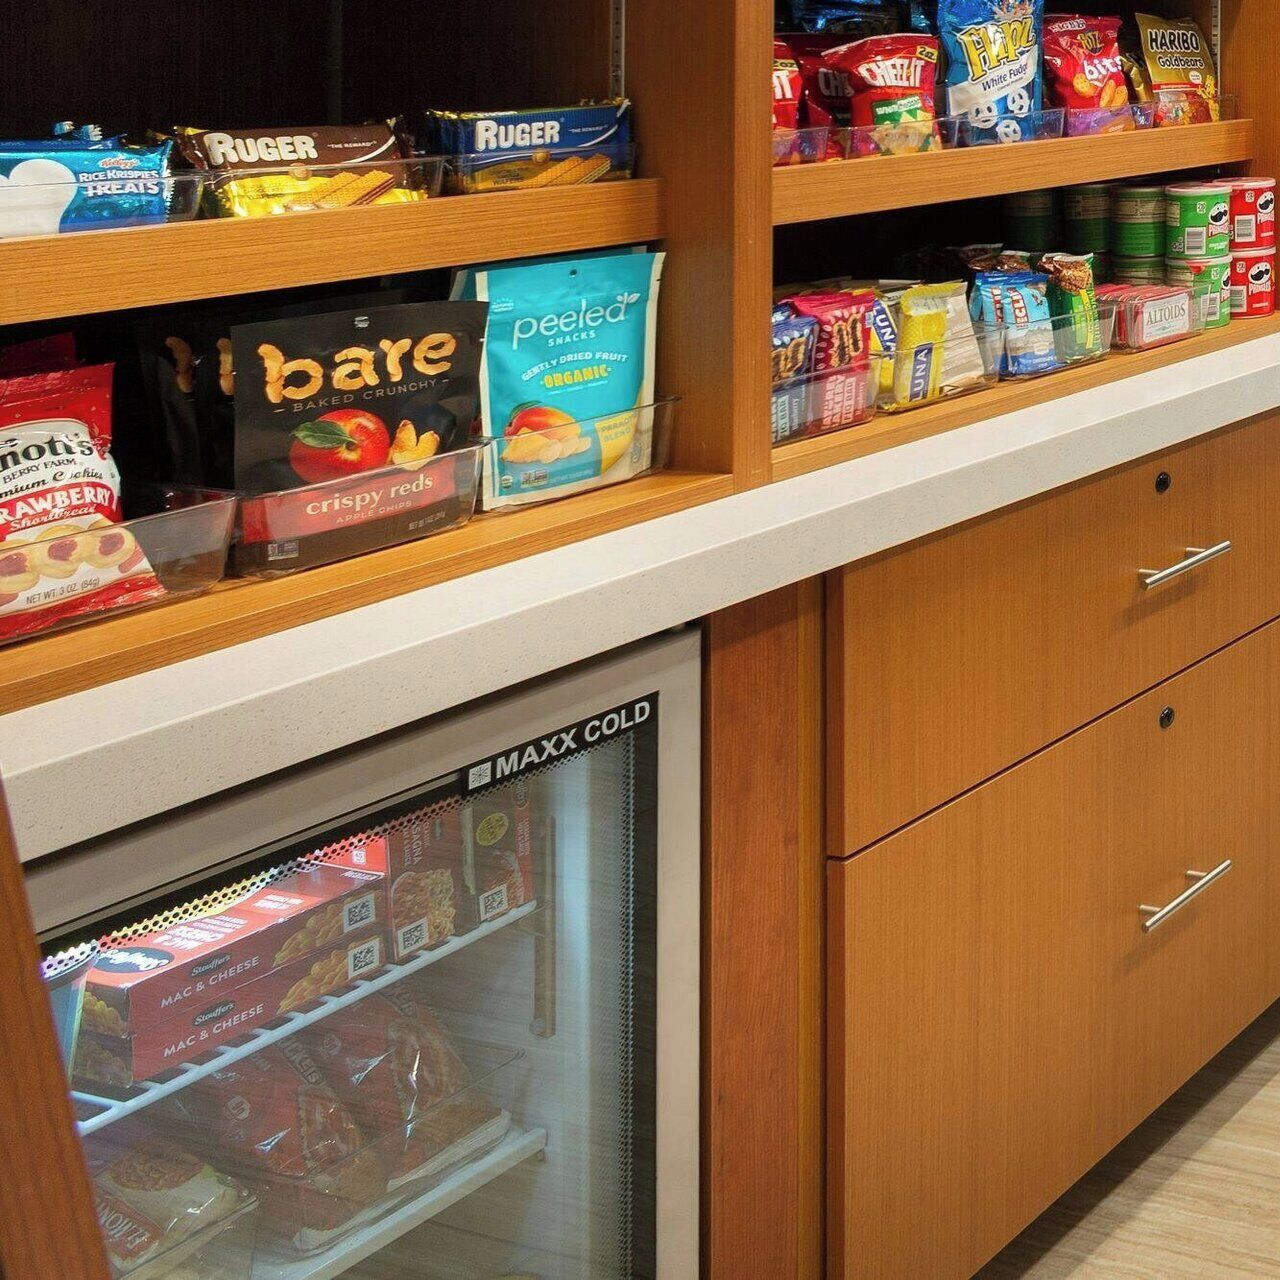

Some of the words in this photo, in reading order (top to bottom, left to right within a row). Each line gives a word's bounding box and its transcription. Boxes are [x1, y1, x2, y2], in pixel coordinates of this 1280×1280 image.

[957, 16, 1036, 82] Flipz
[1148, 29, 1201, 52] HARIBO
[1157, 54, 1205, 69] Goldbears
[981, 74, 1007, 92] White
[475, 119, 561, 150] RUGER
[206, 131, 317, 166] RUGER
[78, 170, 106, 184] RICE
[106, 167, 159, 182] KRISPIES
[84, 180, 160, 197] TREATS
[511, 293, 632, 351] peeled
[1146, 304, 1187, 325] ALTOIDS
[547, 328, 597, 347] SNACKS
[257, 332, 457, 404] bare
[558, 351, 593, 365] DRIED
[594, 351, 629, 363] FRUIT
[543, 364, 609, 388] ORGANIC
[912, 347, 929, 401] LUNA
[293, 393, 354, 413] BAKED
[362, 378, 438, 400] CRUNCHY
[3, 464, 41, 484] BERRY
[43, 457, 77, 472] FARM
[306, 489, 384, 516] crispy
[390, 473, 434, 499] reds
[336, 508, 375, 524] APPLE
[377, 500, 412, 515] CHIPS
[26, 593, 43, 605] NET
[59, 588, 65, 598] 3
[80, 577, 101, 591] (84g)
[496, 727, 577, 779] MAXX
[584, 700, 651, 743] COLD
[191, 952, 232, 976] Stouffer's
[160, 988, 192, 1008] MAC
[196, 978, 205, 991] &
[208, 954, 261, 987] CHEESE
[194, 1000, 236, 1026] Stouffer's
[163, 1036, 196, 1058] MAC
[200, 1026, 209, 1040] &
[212, 1002, 265, 1035] CHEESE
